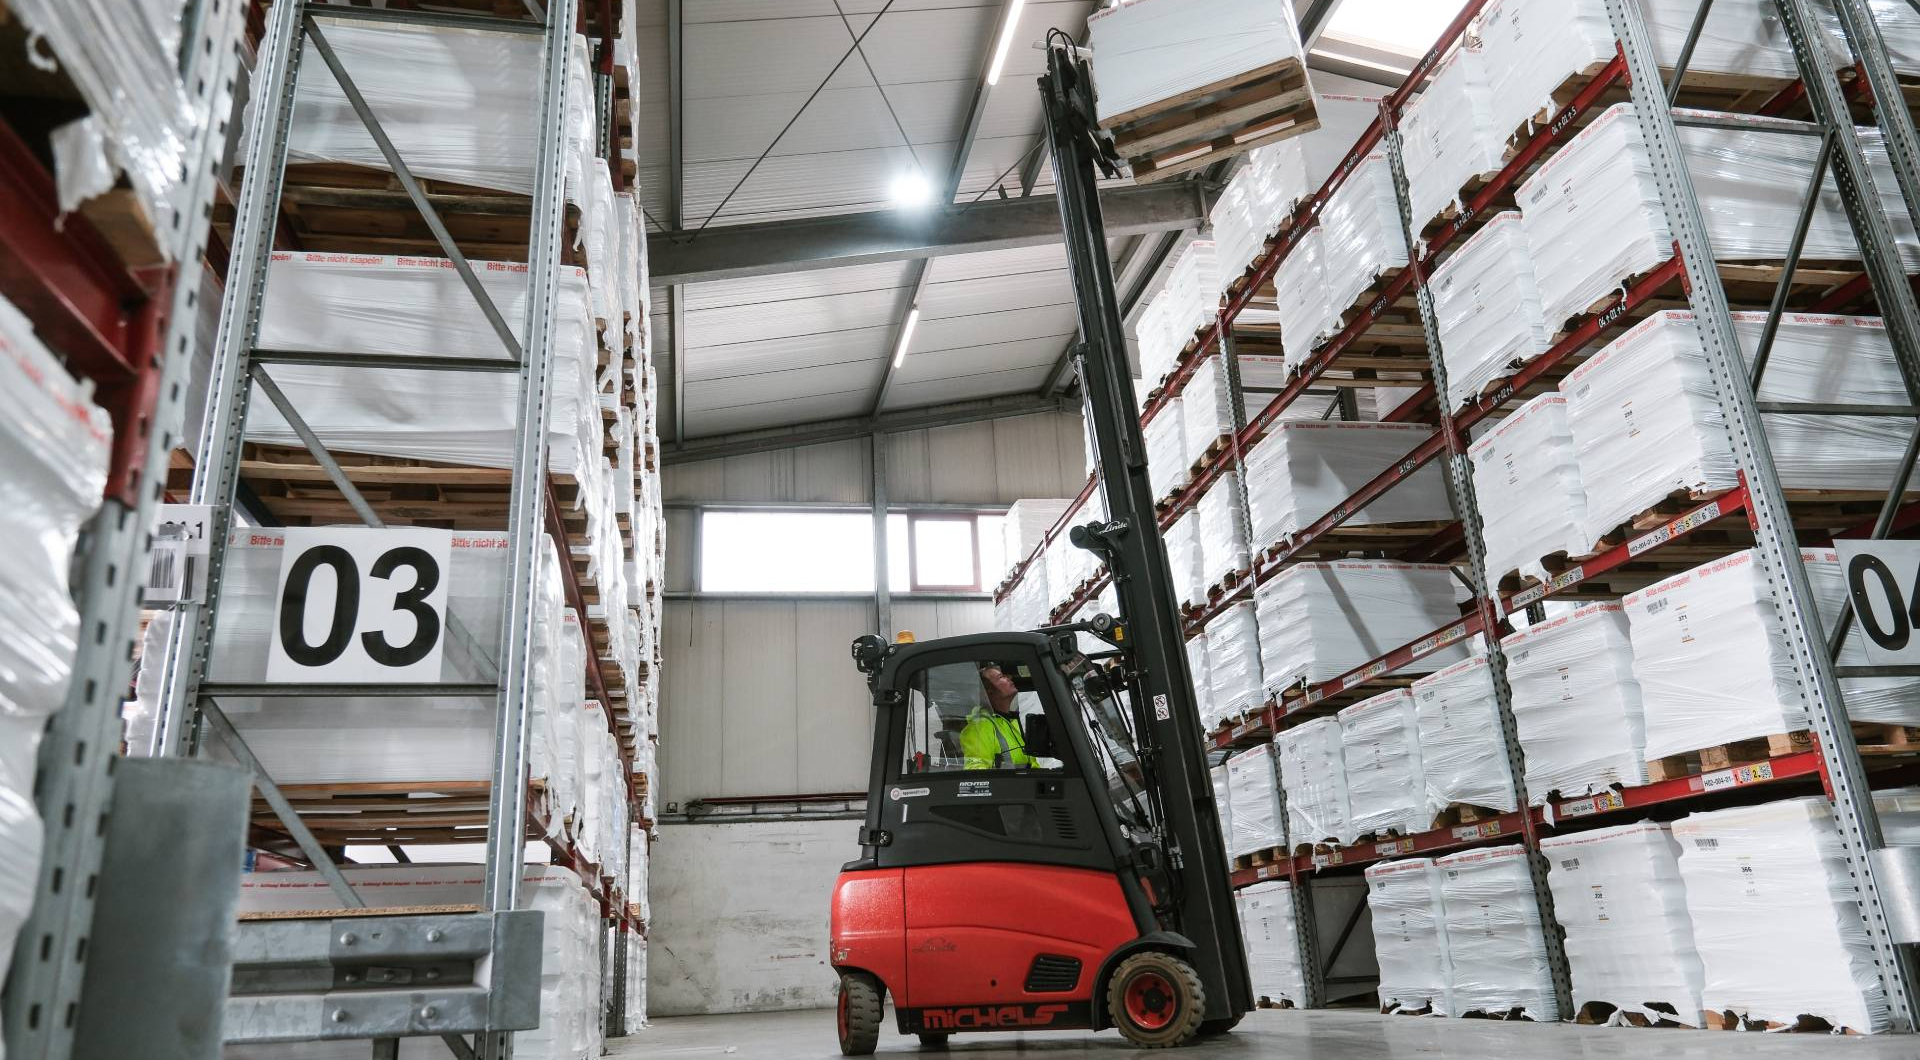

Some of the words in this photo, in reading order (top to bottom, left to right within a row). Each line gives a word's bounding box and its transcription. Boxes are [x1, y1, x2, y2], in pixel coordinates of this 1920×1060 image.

[306, 253, 325, 262] Bitte
[327, 254, 349, 263] nicht
[350, 255, 384, 266] stapeln!
[397, 257, 417, 266] Bitte
[418, 258, 439, 267] nicht
[487, 262, 506, 271] Bitte
[507, 263, 529, 273] nicht
[1097, 520, 1127, 534] Linde
[251, 535, 271, 546] Bitte
[451, 537, 470, 548] Bitte
[472, 537, 495, 548] nicht
[280, 545, 440, 667] 03
[1848, 553, 1920, 651] 0
